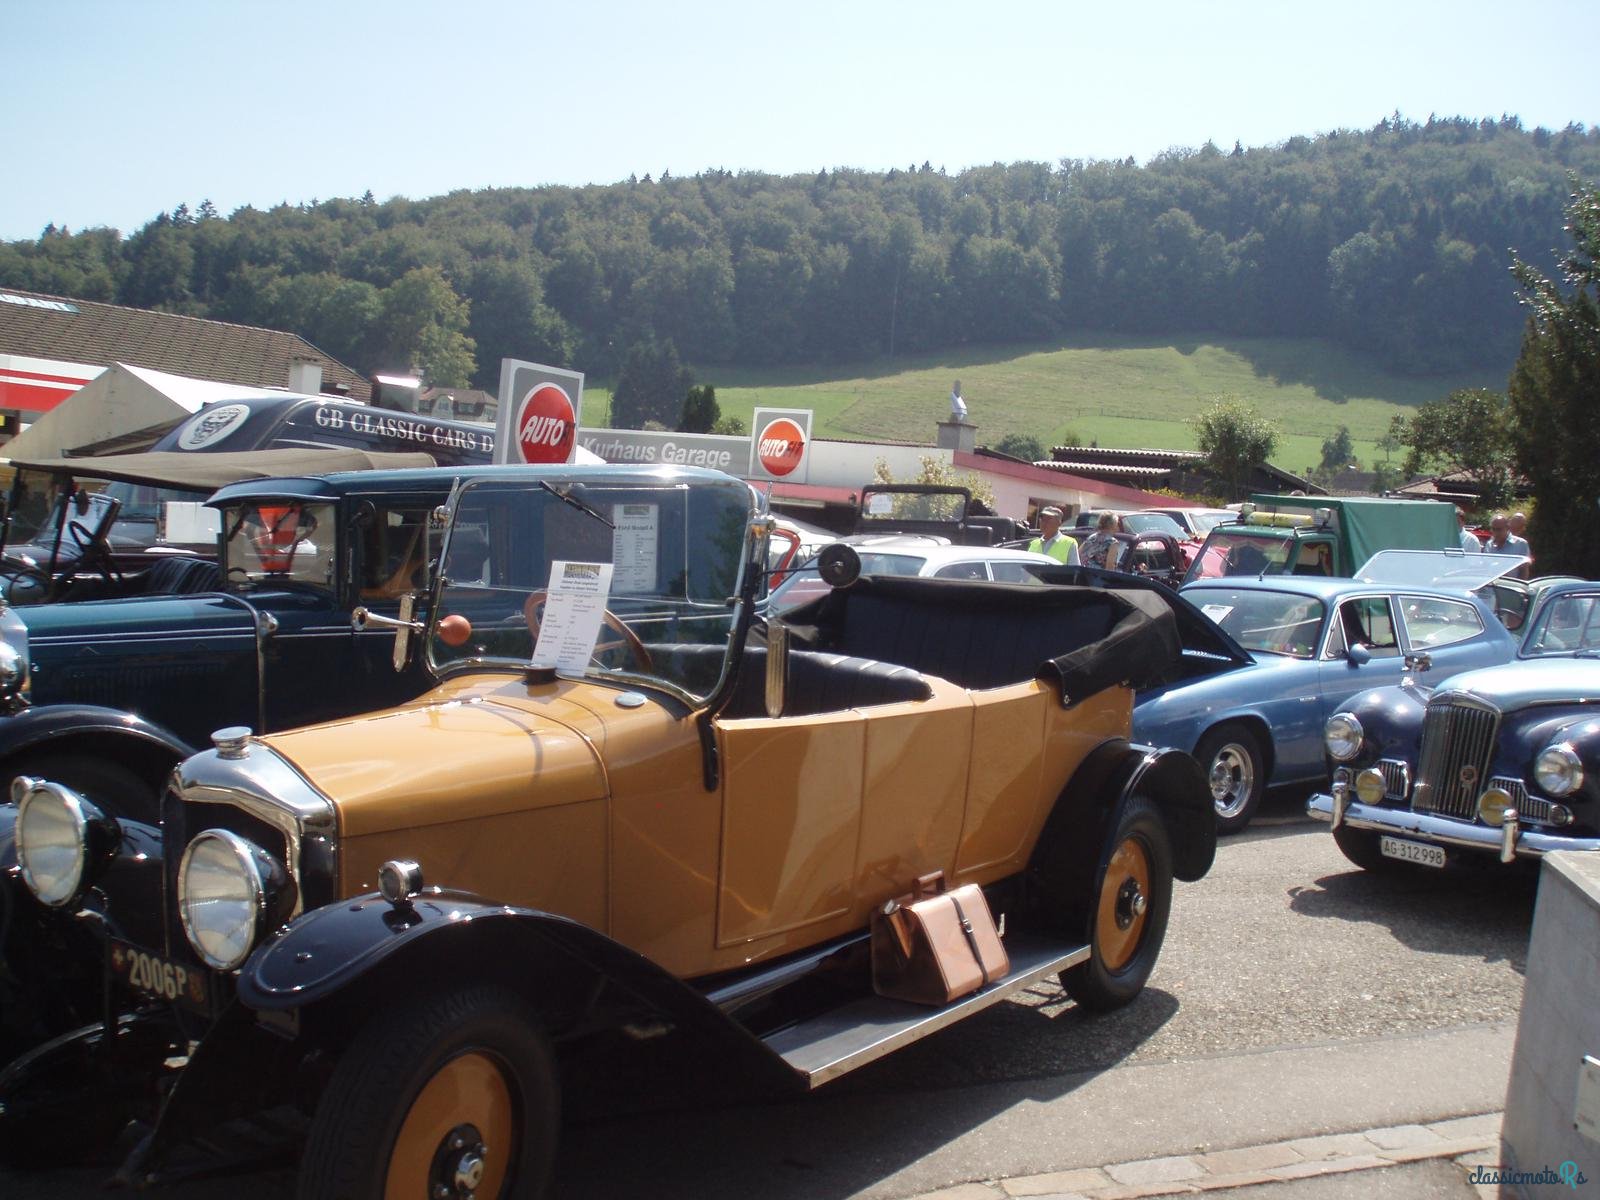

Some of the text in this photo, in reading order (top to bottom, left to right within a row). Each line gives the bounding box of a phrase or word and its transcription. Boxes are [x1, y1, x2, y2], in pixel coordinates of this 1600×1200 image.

[315, 407, 344, 428] GB
[350, 412, 427, 442] CLASSIC
[432, 426, 476, 450] CARS
[583, 437, 732, 467] Kurhaus Garage
